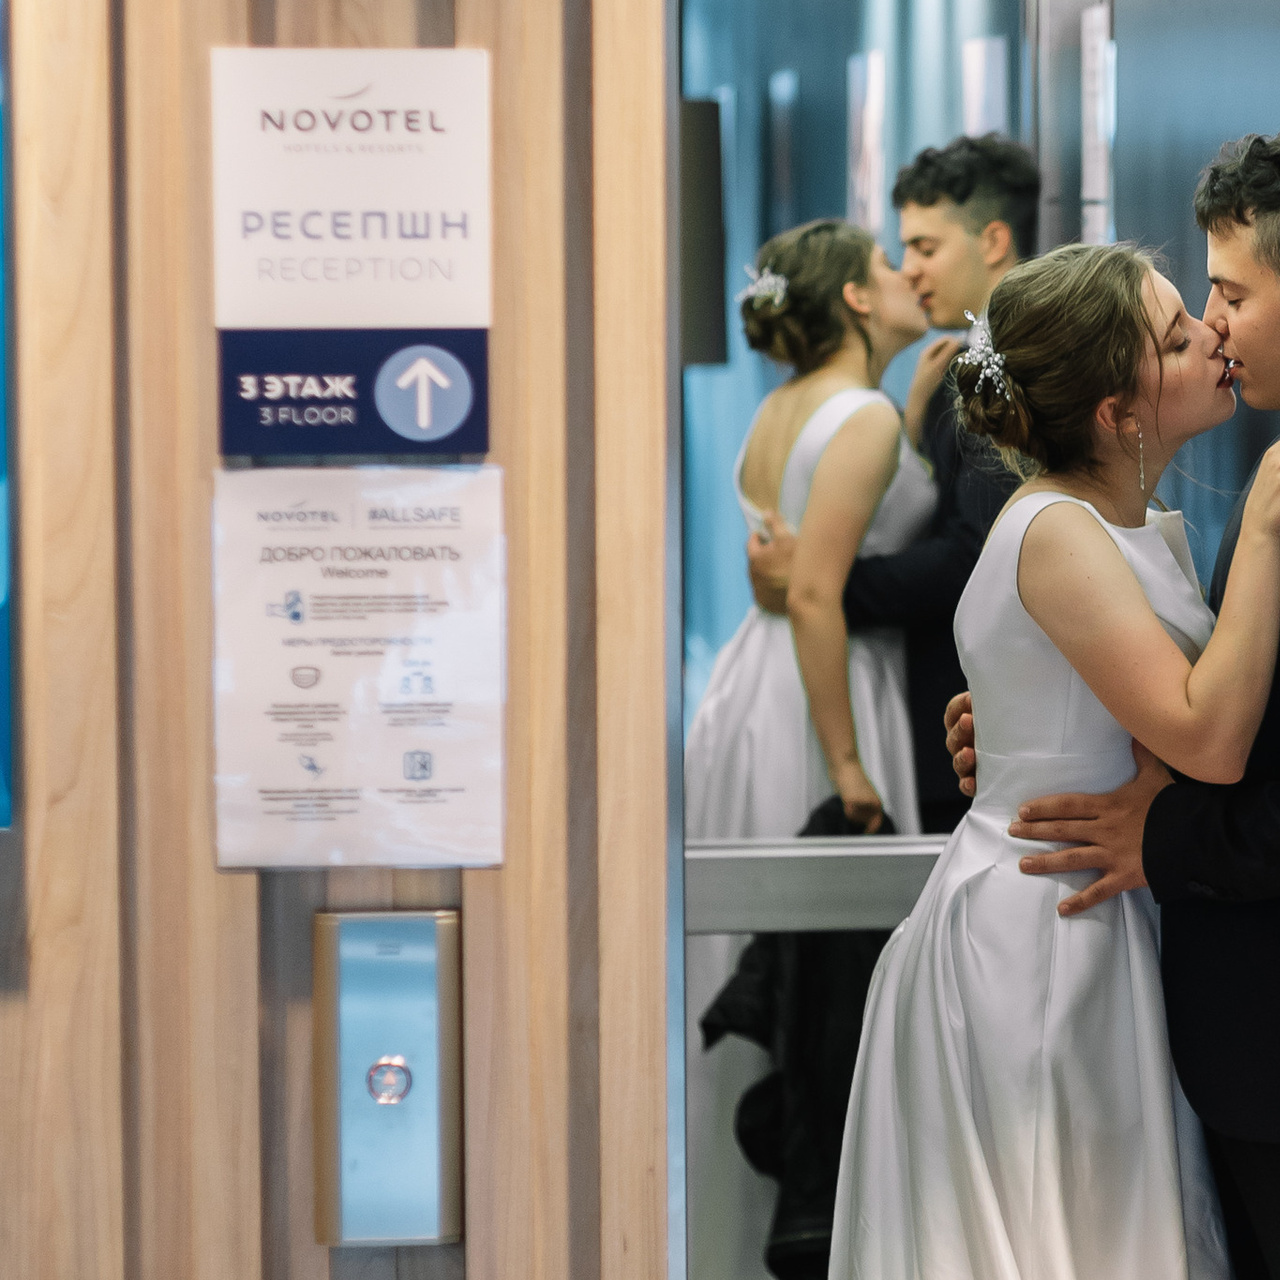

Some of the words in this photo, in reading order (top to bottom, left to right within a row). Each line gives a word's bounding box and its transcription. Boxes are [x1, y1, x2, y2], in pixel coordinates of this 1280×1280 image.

[260, 109, 447, 133] NOVOTEL
[241, 210, 469, 240] РЕСЕПШН
[257, 257, 455, 281] RECEPTION
[238, 375, 258, 400] 3
[263, 375, 358, 400] ЭТАЖ
[259, 407, 274, 425] 3
[278, 407, 357, 425] FLOOR
[257, 509, 340, 523] NOVOTEL
[368, 507, 461, 523] #ALLSAFE
[259, 546, 325, 563] ДОБРО
[330, 546, 461, 562] ПОЖАЛОВАТЬ
[320, 566, 390, 579] Welcome
